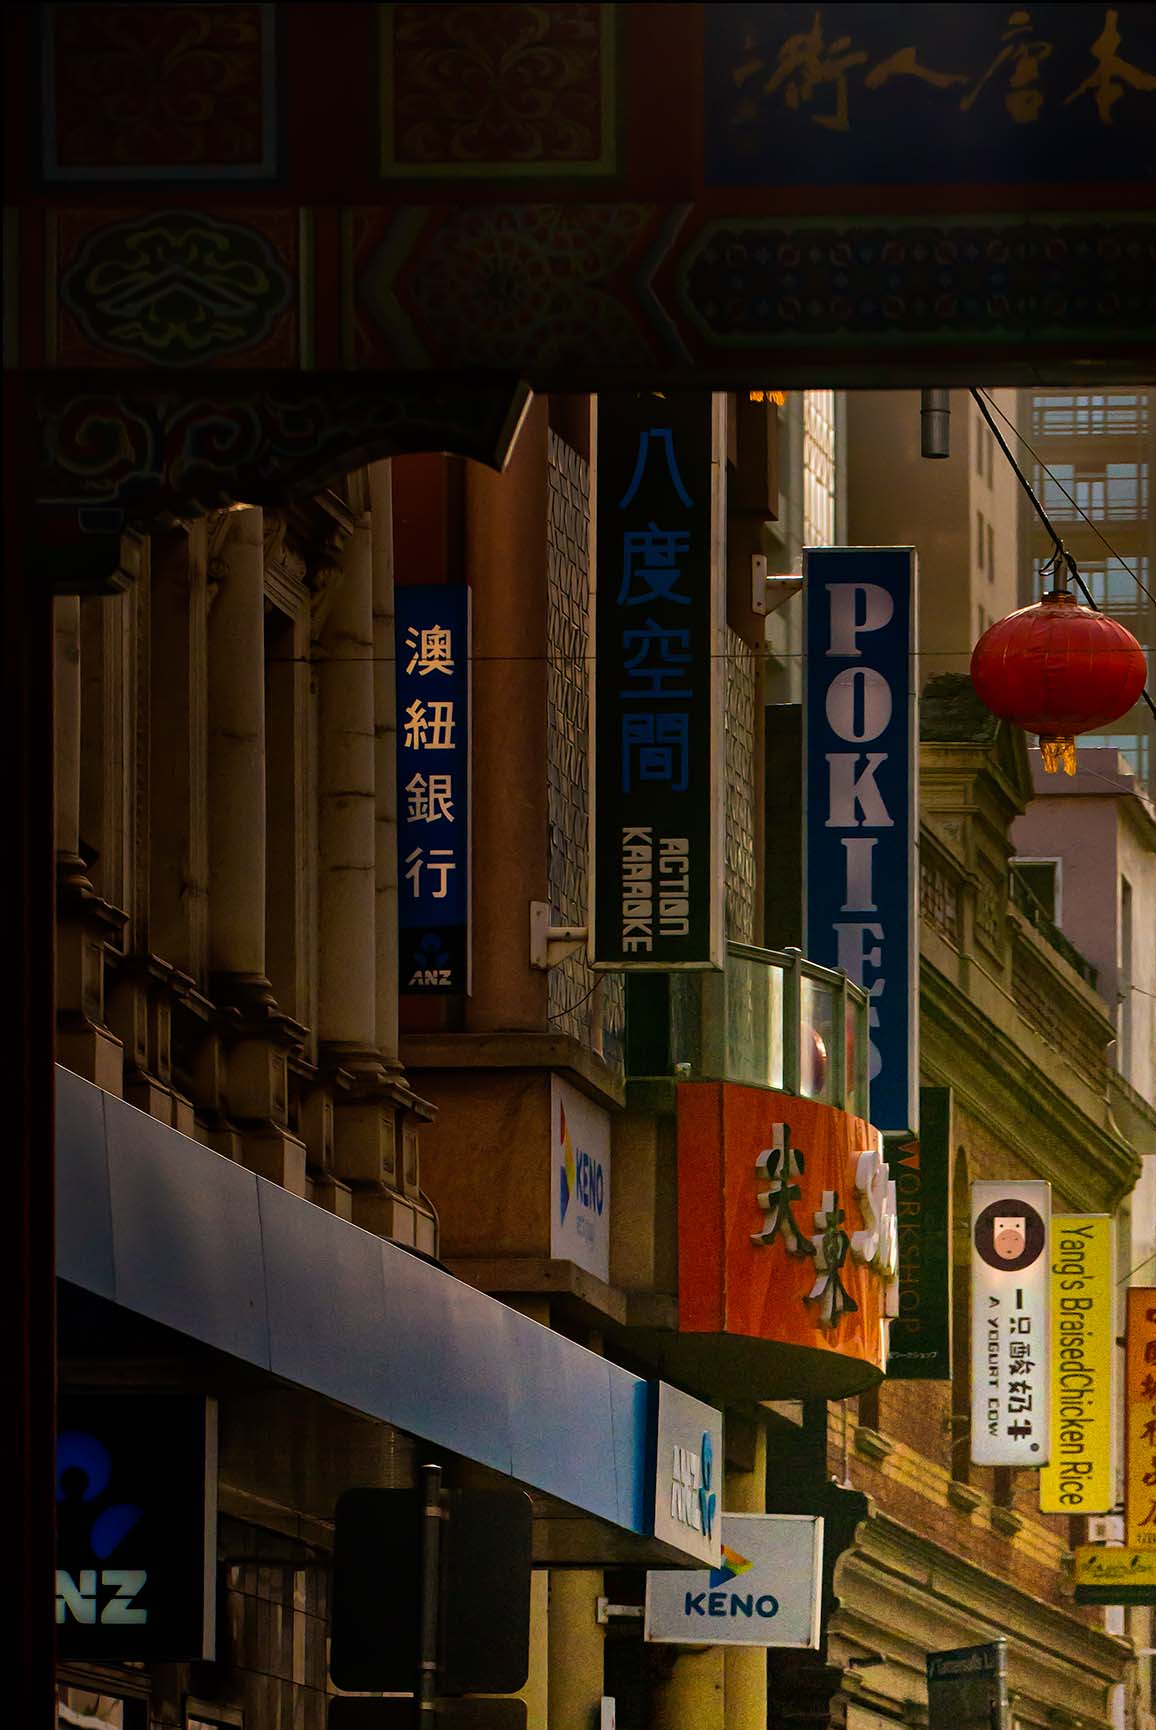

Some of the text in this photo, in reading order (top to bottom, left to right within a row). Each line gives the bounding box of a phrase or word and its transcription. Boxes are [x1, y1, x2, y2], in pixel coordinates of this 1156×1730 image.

[617, 427, 696, 797] 八度空間
[403, 625, 457, 898] 澳紐銀行
[622, 825, 653, 952] KARAOKE
[658, 836, 690, 937] ACTION
[408, 969, 453, 986] ANZ
[575, 1147, 604, 1217] KENO
[1052, 1225, 1094, 1291] Yang's
[987, 1317, 999, 1388] YOGURT
[987, 1398, 999, 1437] COW
[1059, 1461, 1093, 1506] Rice
[55, 1569, 148, 1625] NZ
[684, 1591, 779, 1618] KENO
